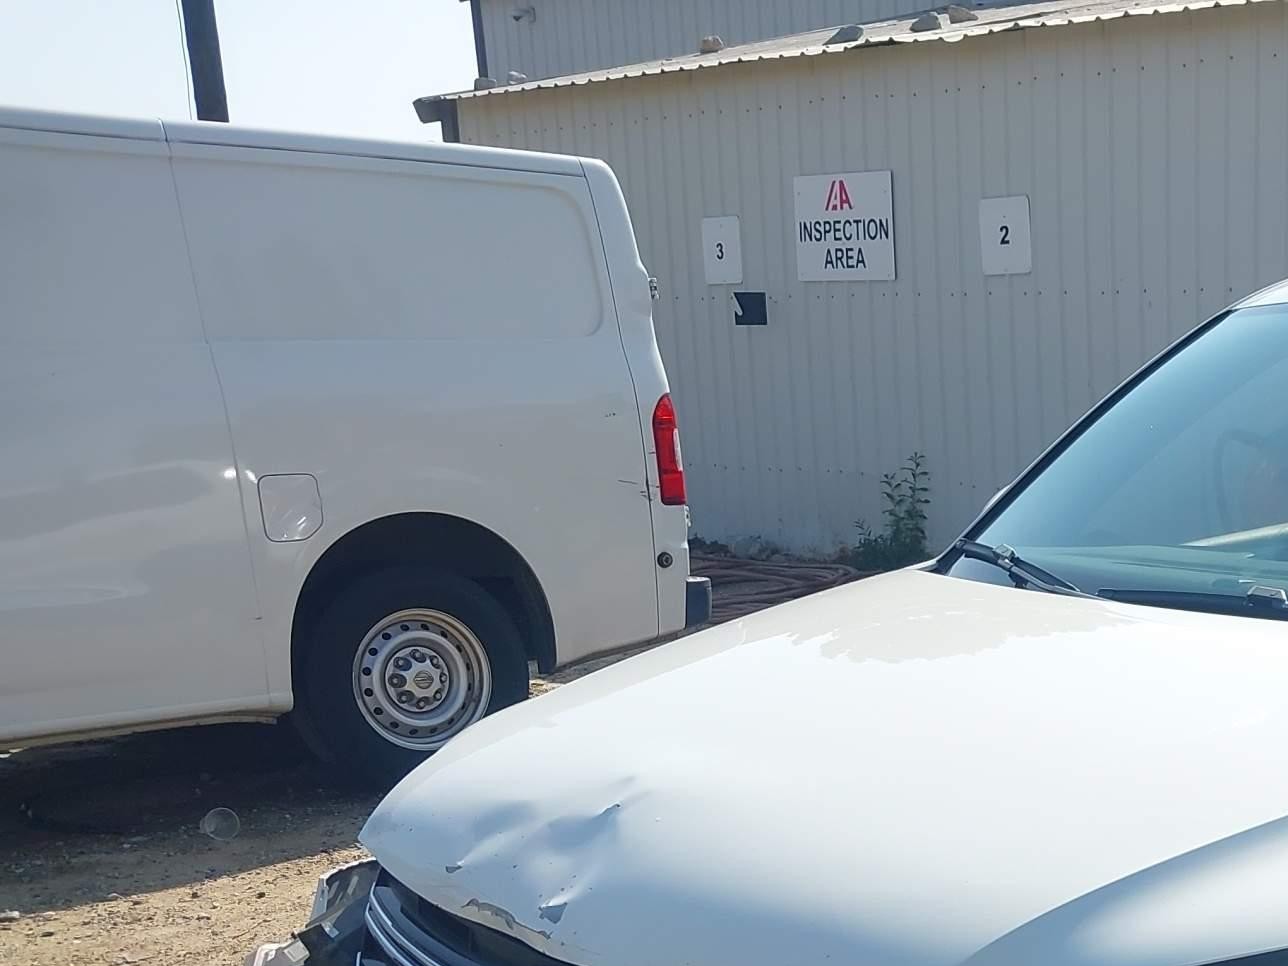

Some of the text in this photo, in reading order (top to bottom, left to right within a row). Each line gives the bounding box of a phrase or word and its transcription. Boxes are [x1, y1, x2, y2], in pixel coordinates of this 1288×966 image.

[799, 218, 889, 243] INSPECTION
[1000, 225, 1010, 245] 2
[716, 242, 724, 260] 3
[824, 247, 866, 270] AREA
